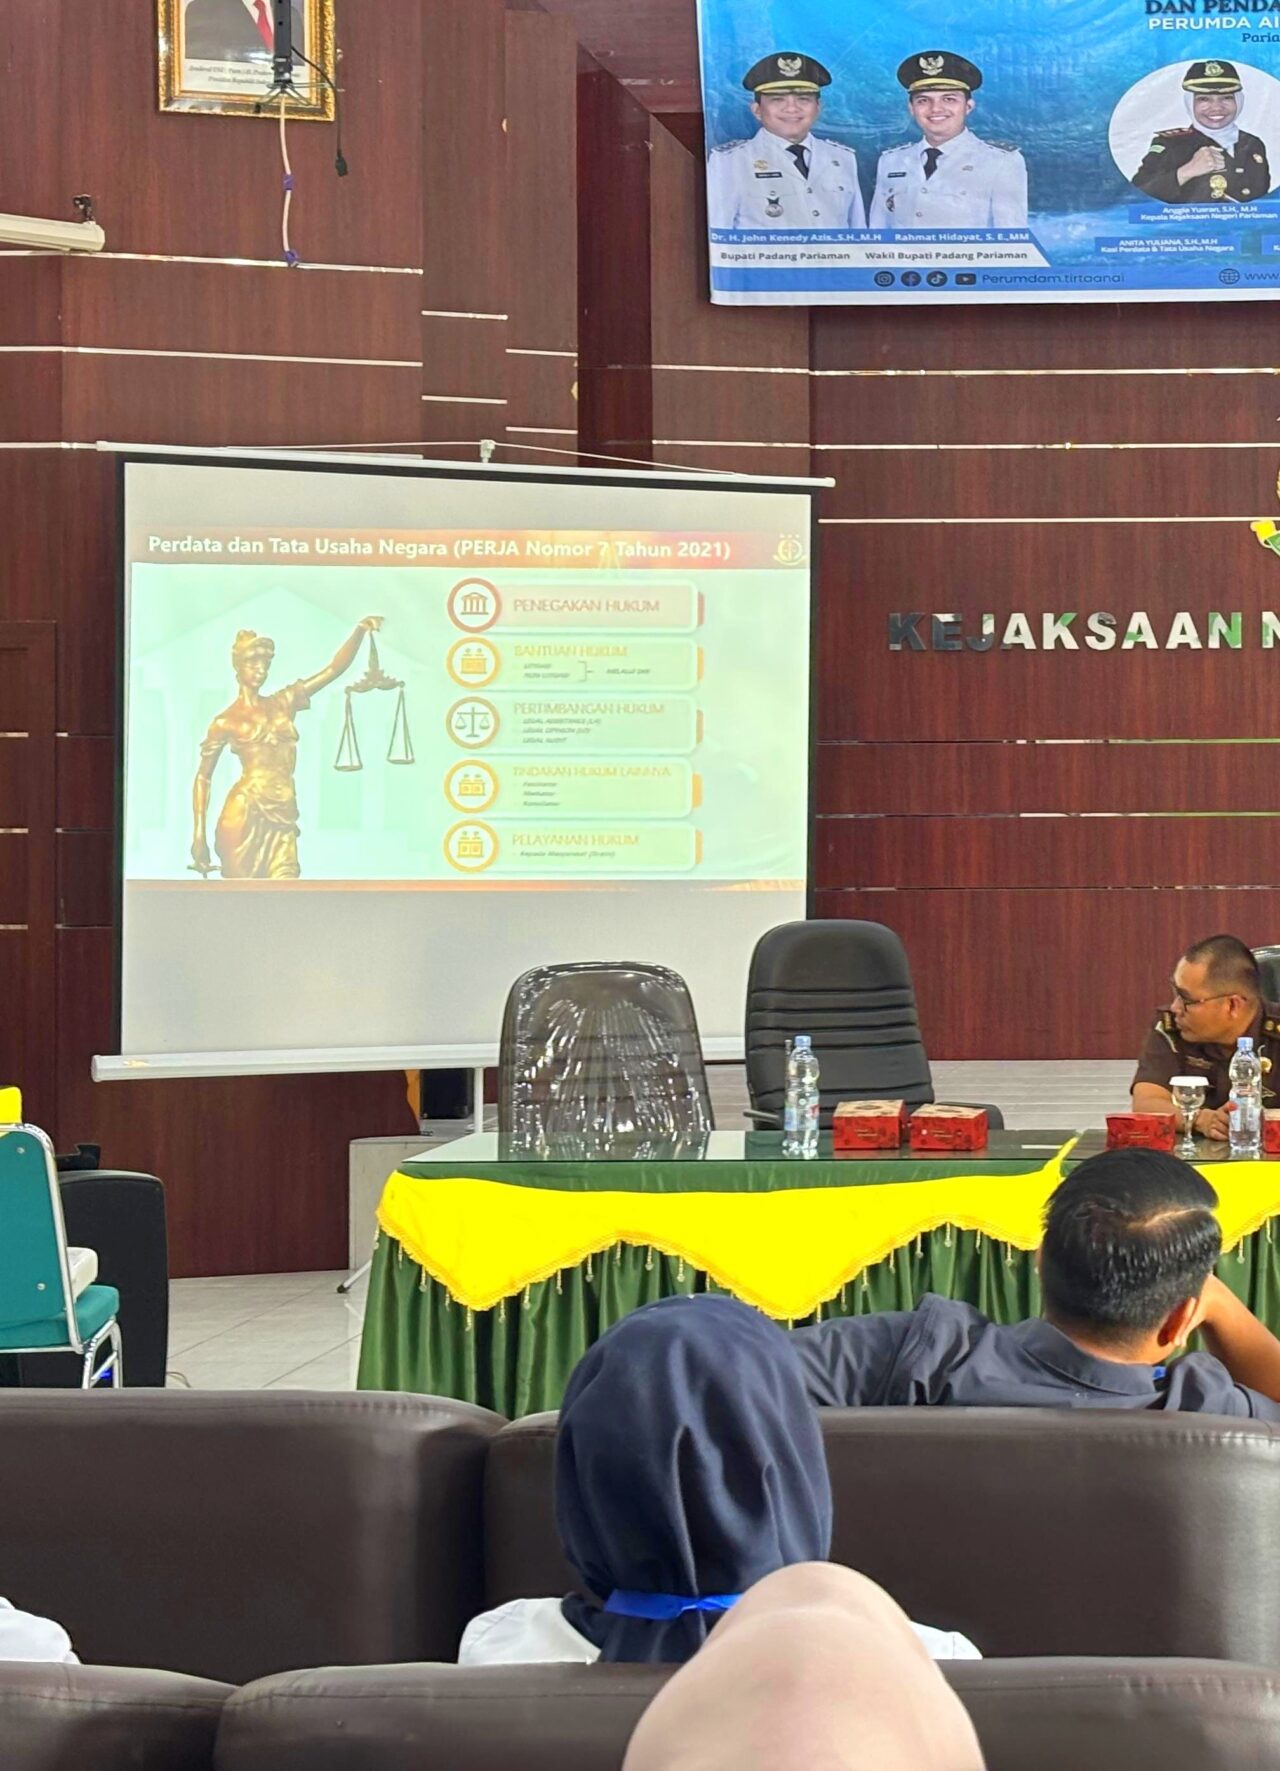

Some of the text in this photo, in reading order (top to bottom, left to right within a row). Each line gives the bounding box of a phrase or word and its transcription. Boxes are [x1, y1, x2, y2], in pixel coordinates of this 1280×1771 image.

[1145, 0, 1195, 14] DAN
[1149, 16, 1251, 30] PERUMDA
[711, 233, 727, 241] Dr.
[729, 233, 741, 241] H.
[742, 233, 767, 243] John
[769, 233, 809, 243] Kenedy
[895, 233, 936, 242] Rahmat
[721, 251, 851, 261] Bupati Padang Pariaman
[865, 251, 1028, 261] Wakil Bupati Padang Pariaman
[982, 273, 1125, 285] Perumdam.tirtaanai
[149, 536, 222, 552] Perdata
[228, 537, 264, 553] dan
[268, 537, 309, 554] Tata
[315, 538, 373, 554] Usaha
[379, 539, 448, 559] Negara
[453, 539, 521, 558] (PERJA
[526, 540, 593, 557] Nomor
[616, 541, 672, 557] Tahun
[677, 541, 731, 560] 2021)
[514, 599, 660, 613] PENEGAKAN HUKUM
[888, 611, 1244, 652] KEJAKSAAN
[514, 645, 629, 656] BANTUAN HUKUM
[514, 703, 665, 714] PERTIMBANGAN HUKUM
[512, 767, 571, 777] TINDAKAN
[574, 767, 617, 777] HUKUM
[512, 834, 640, 846] PELAYANAN HUKUM
